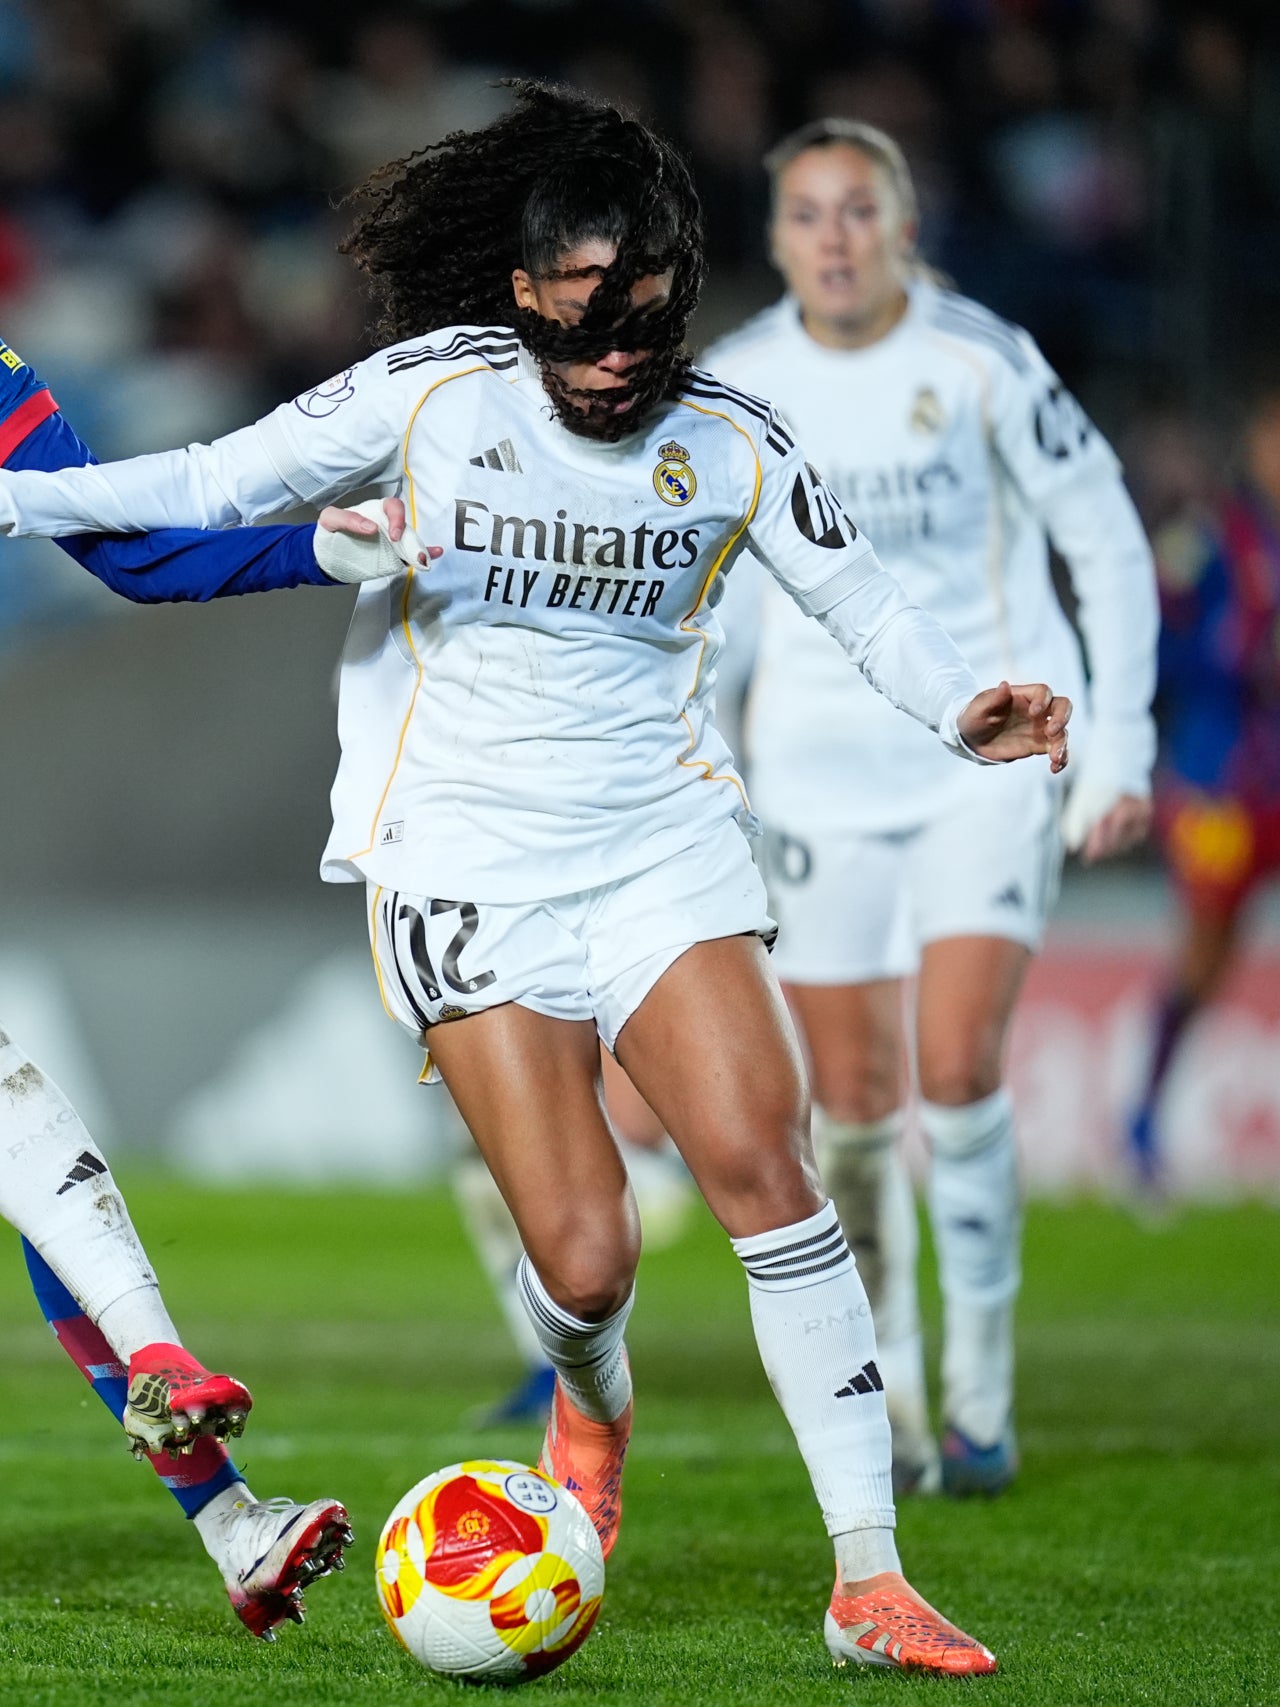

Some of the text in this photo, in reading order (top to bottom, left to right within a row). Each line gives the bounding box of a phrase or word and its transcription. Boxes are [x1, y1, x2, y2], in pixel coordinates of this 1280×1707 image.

[454, 498, 700, 570] Emirates
[484, 565, 665, 618] FLY BETTER
[398, 898, 498, 1002] 12
